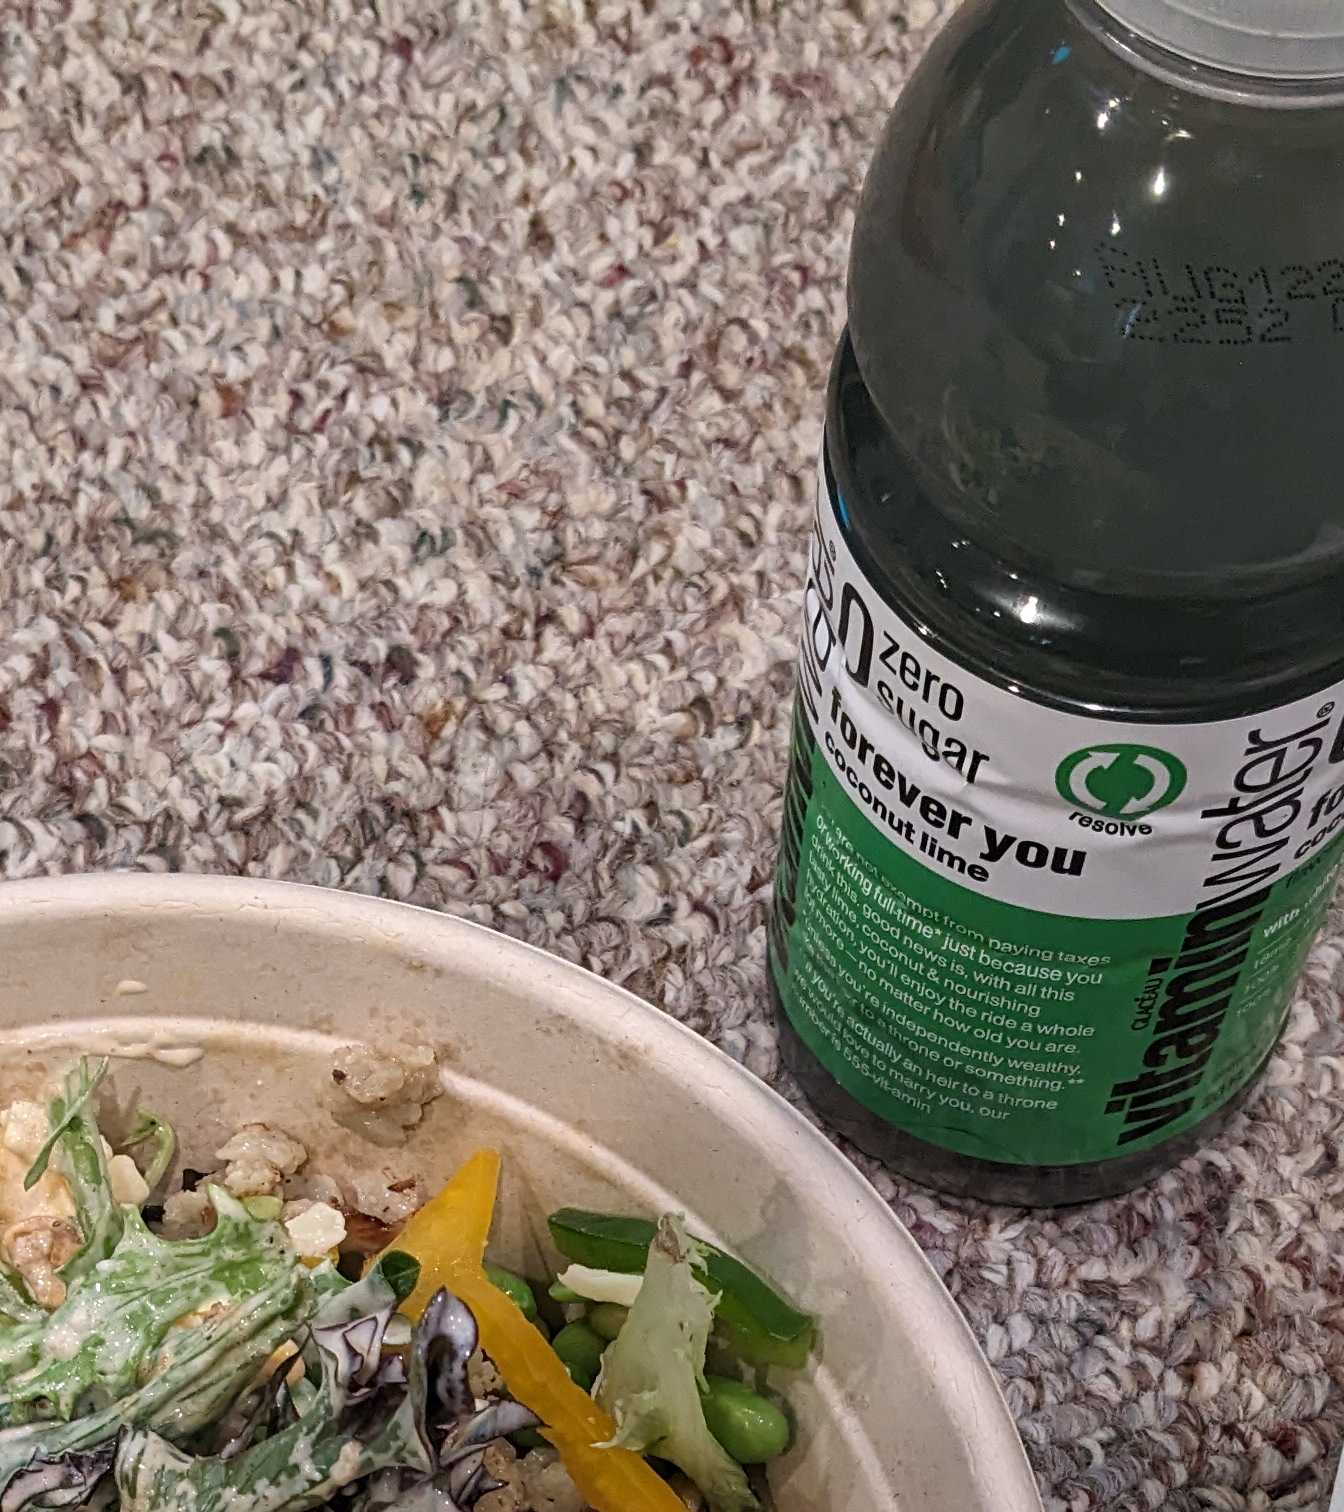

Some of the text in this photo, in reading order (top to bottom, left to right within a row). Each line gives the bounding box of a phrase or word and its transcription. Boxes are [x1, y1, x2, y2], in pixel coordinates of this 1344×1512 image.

[879, 630, 964, 721] zero
[877, 680, 990, 785] sugar
[824, 731, 989, 882] coconut lime
[830, 686, 1087, 876] forever you
[1068, 810, 1153, 837] resolve
[826, 831, 872, 896] working
[942, 932, 976, 961] just
[978, 950, 1062, 982] because
[1066, 972, 1103, 986] you
[862, 903, 901, 941] good
[902, 934, 947, 967] news
[973, 970, 1011, 991] with
[1014, 983, 1037, 997] all
[1040, 986, 1076, 1001] this
[943, 914, 984, 943] from
[989, 937, 1054, 961] paying
[1057, 951, 1112, 968] taxes
[858, 961, 877, 981] no
[879, 976, 930, 1015] matter
[933, 1008, 971, 1033] how
[973, 1028, 1003, 1043] old
[1006, 1036, 1041, 1051] you
[862, 924, 924, 976] coconut
[944, 977, 1041, 1018] nourishing
[900, 973, 946, 1006] enjoy
[948, 998, 977, 1018] the
[980, 1011, 1017, 1030] ride
[1020, 1022, 1032, 1032] a
[1036, 1024, 1096, 1037] whole
[846, 1015, 902, 1064] actually
[902, 1057, 923, 1076] an
[925, 1068, 960, 1091] heir
[962, 1082, 980, 1096] to
[982, 1090, 994, 1100] a
[998, 1092, 1059, 1110] throne
[882, 1001, 1004, 1067] independently
[943, 1056, 964, 1070] or
[871, 1055, 887, 1071] to
[888, 1067, 936, 1100] marry
[979, 1106, 1011, 1120] our
